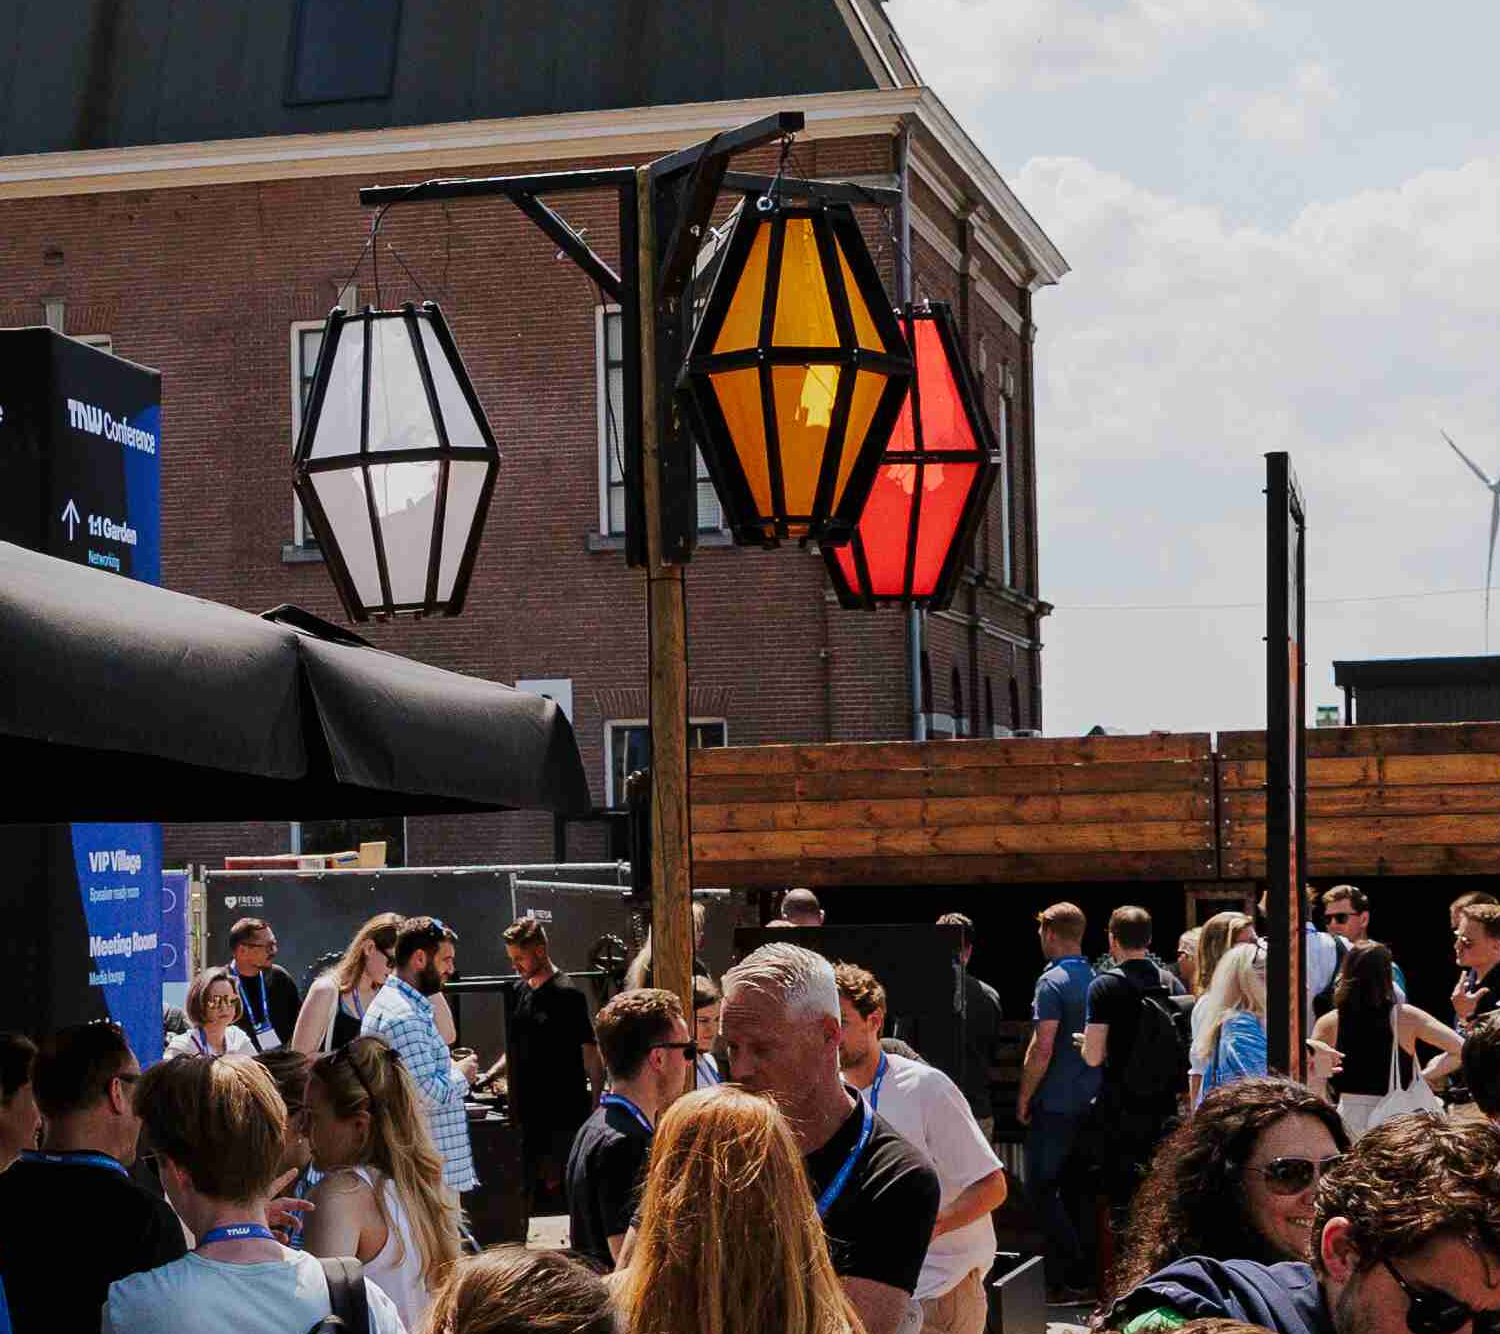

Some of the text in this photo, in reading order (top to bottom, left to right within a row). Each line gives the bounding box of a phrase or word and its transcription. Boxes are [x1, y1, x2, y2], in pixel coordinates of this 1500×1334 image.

[67, 398, 155, 454] TNW Conference
[88, 513, 137, 545] 1:1 Garden
[88, 548, 120, 571] Networking
[89, 849, 142, 875] VIP Village
[89, 931, 157, 957] Meeting Rooms
